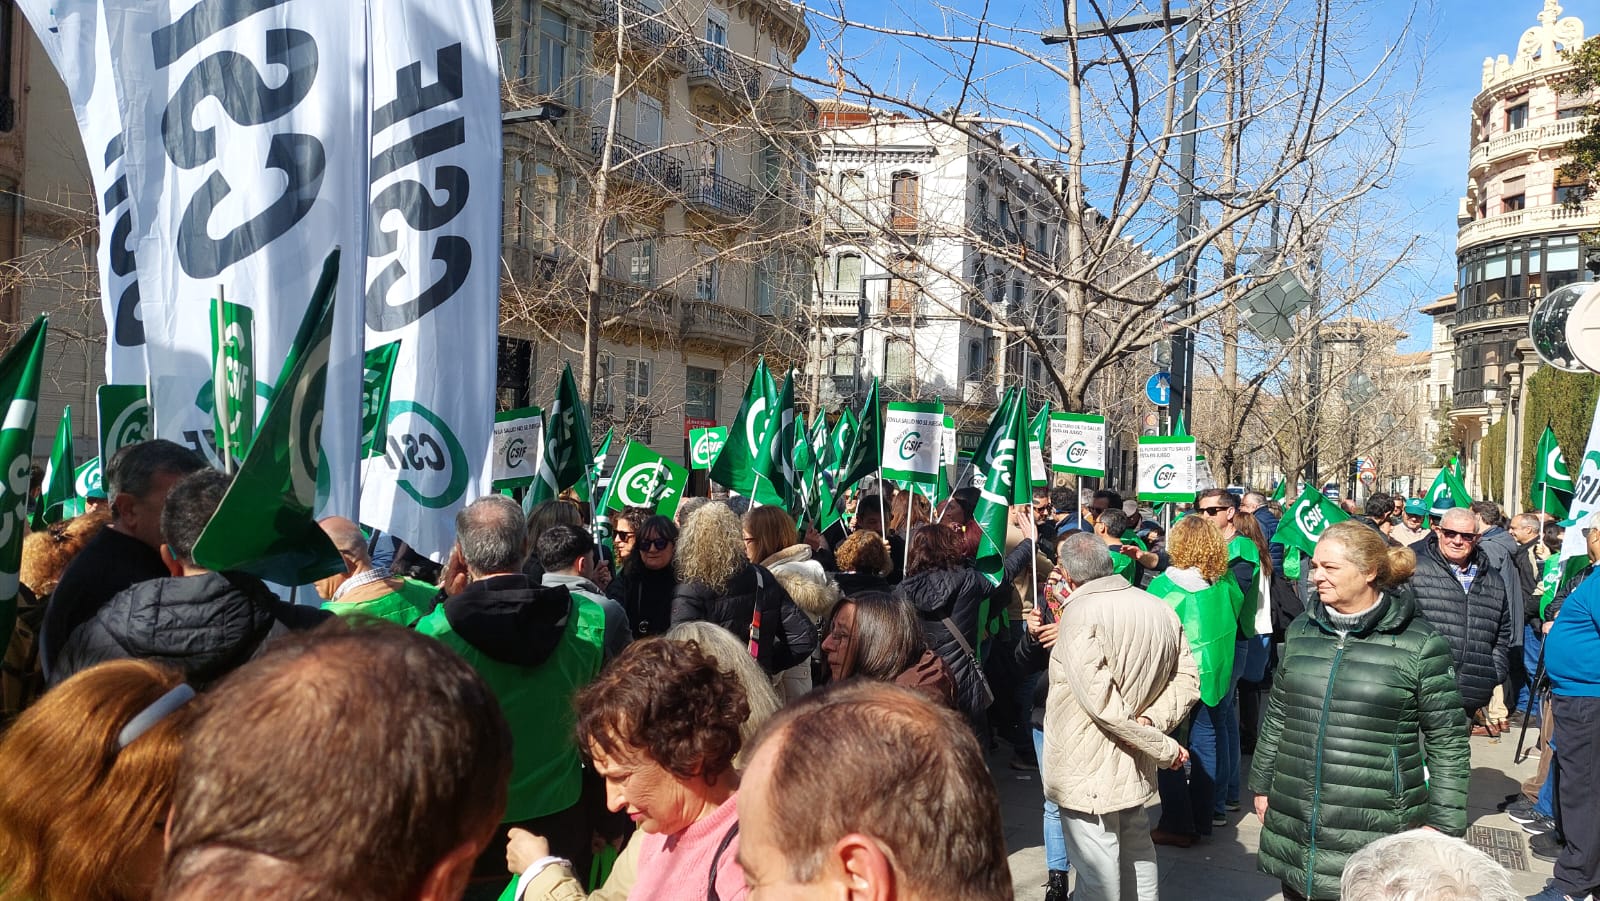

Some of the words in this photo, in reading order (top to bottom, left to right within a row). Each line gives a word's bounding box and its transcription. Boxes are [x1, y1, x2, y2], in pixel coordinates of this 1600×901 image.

[510, 446, 528, 459] CSIF
[698, 441, 725, 454] CSIF
[904, 439, 923, 453] CSIF
[1070, 447, 1089, 457] CSIF
[1158, 471, 1177, 481] CSIF
[631, 473, 676, 501] CSIF
[1303, 503, 1325, 532] CSIF
